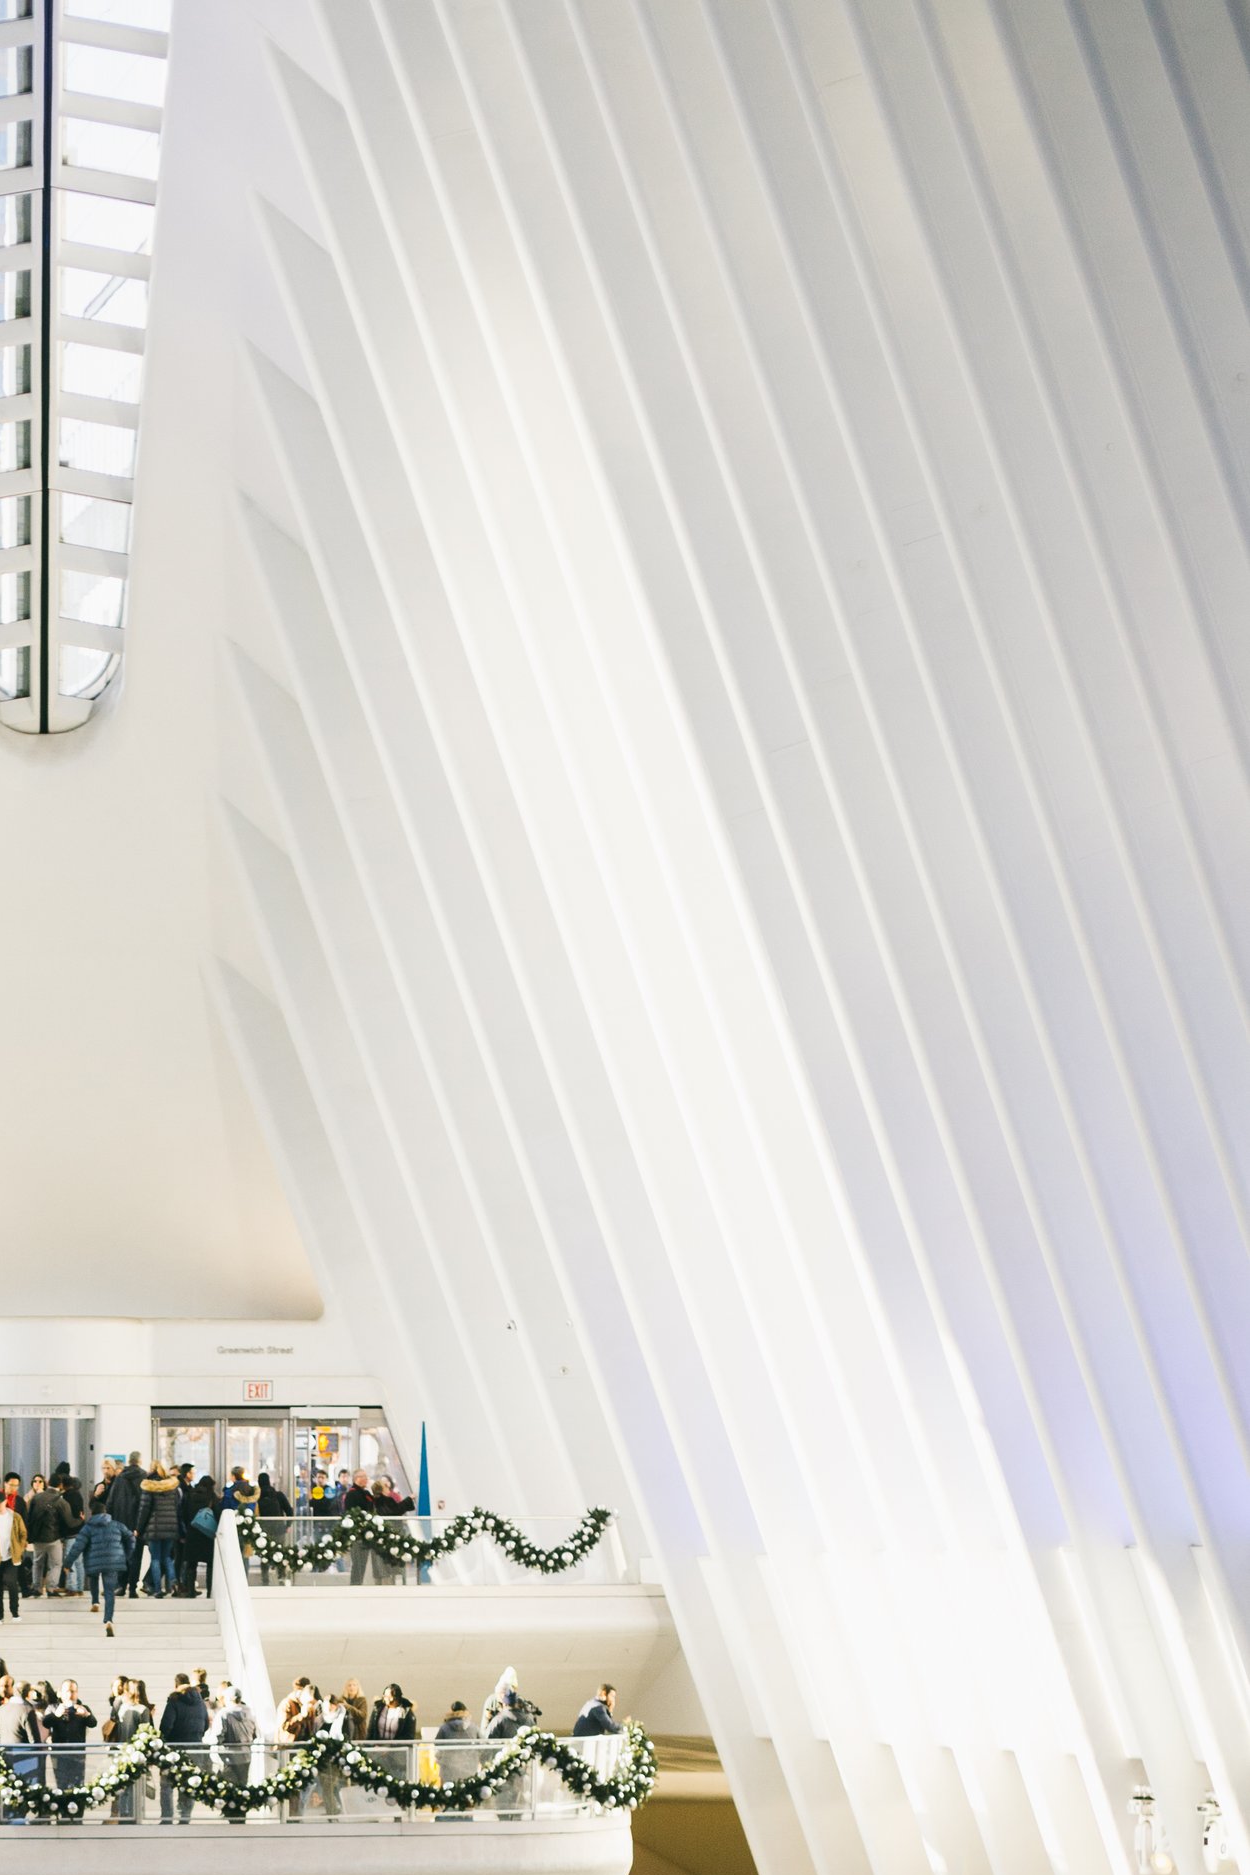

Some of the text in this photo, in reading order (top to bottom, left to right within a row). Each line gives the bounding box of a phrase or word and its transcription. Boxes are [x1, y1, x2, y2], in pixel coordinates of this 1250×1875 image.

[217, 1346, 294, 1354] Greenwich Street
[248, 1383, 269, 1398] EXIT
[21, 1407, 68, 1415] ELEVATOR
